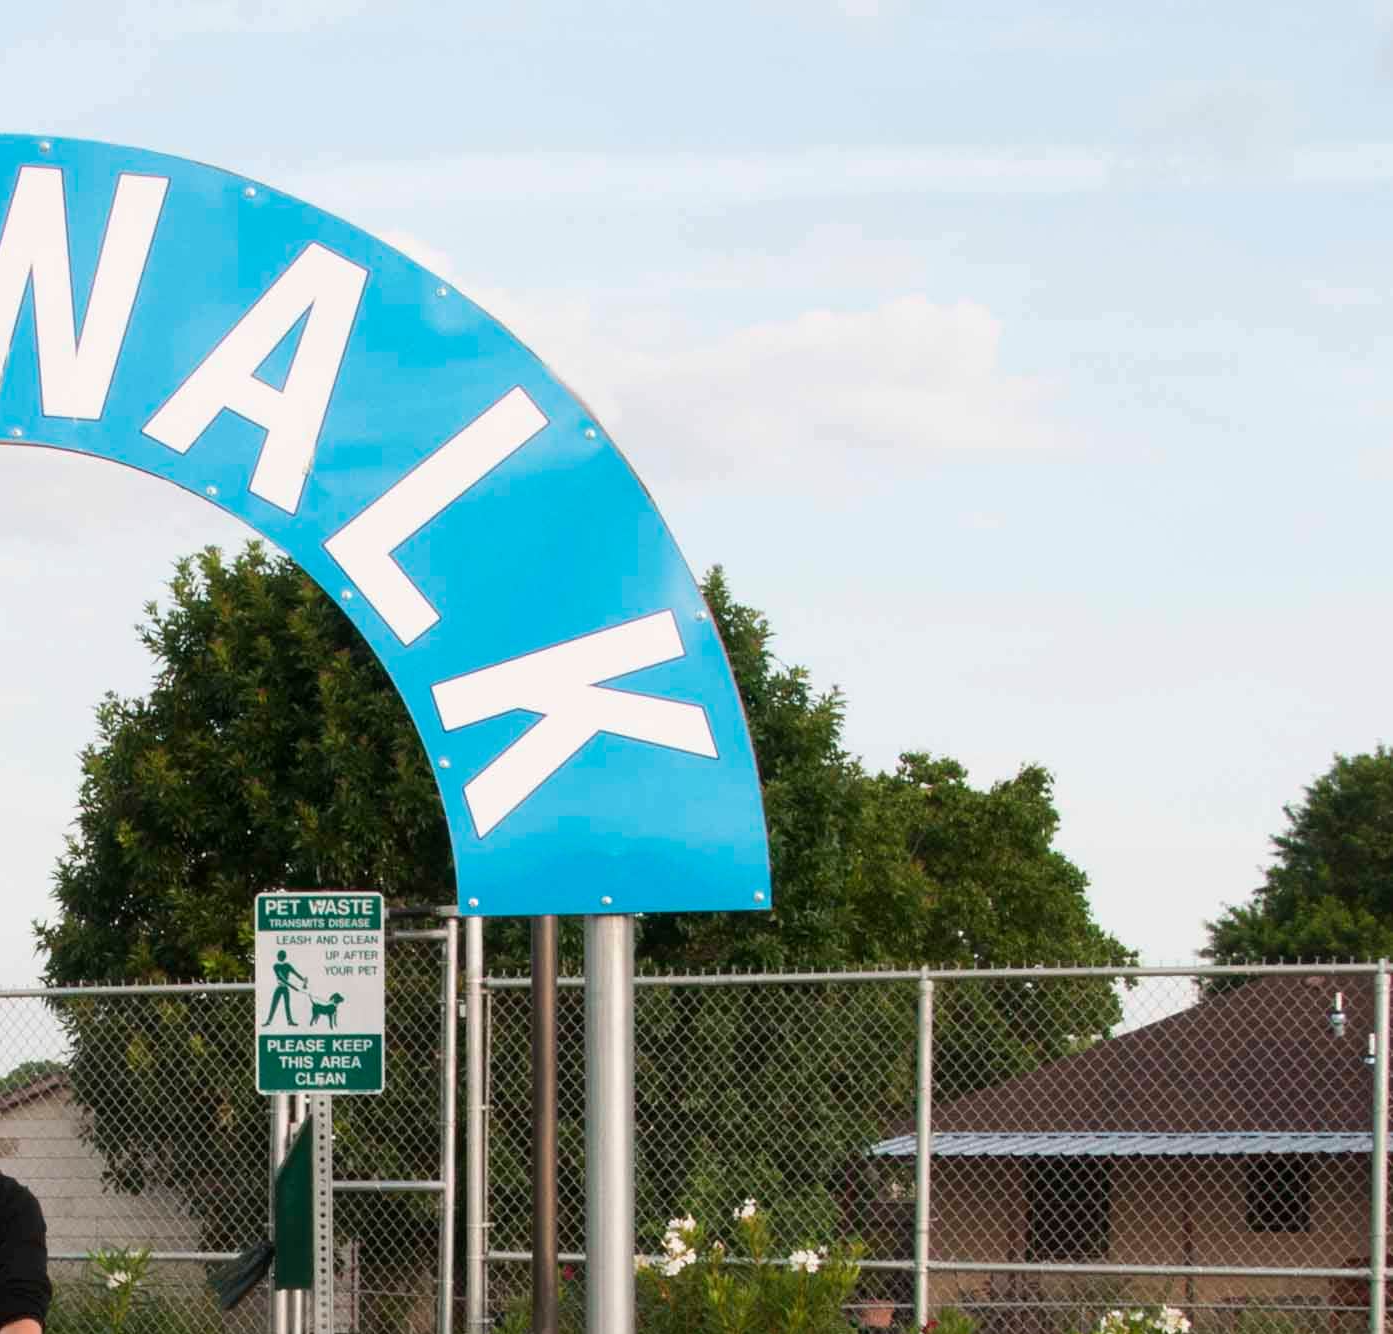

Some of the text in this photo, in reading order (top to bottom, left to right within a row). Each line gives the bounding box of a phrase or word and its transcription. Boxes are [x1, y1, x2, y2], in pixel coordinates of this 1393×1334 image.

[265, 899, 374, 915] PET WASTE
[269, 918, 371, 929] TRANSMITS DISEASE
[276, 935, 378, 945] LEASH AND CLEAN
[325, 950, 378, 961] UP AFTER
[324, 965, 377, 976] YOUR PET
[267, 1039, 373, 1052] PLEASE KEEP
[278, 1056, 362, 1069] THIS AREA
[295, 1072, 346, 1085] CLEAN
